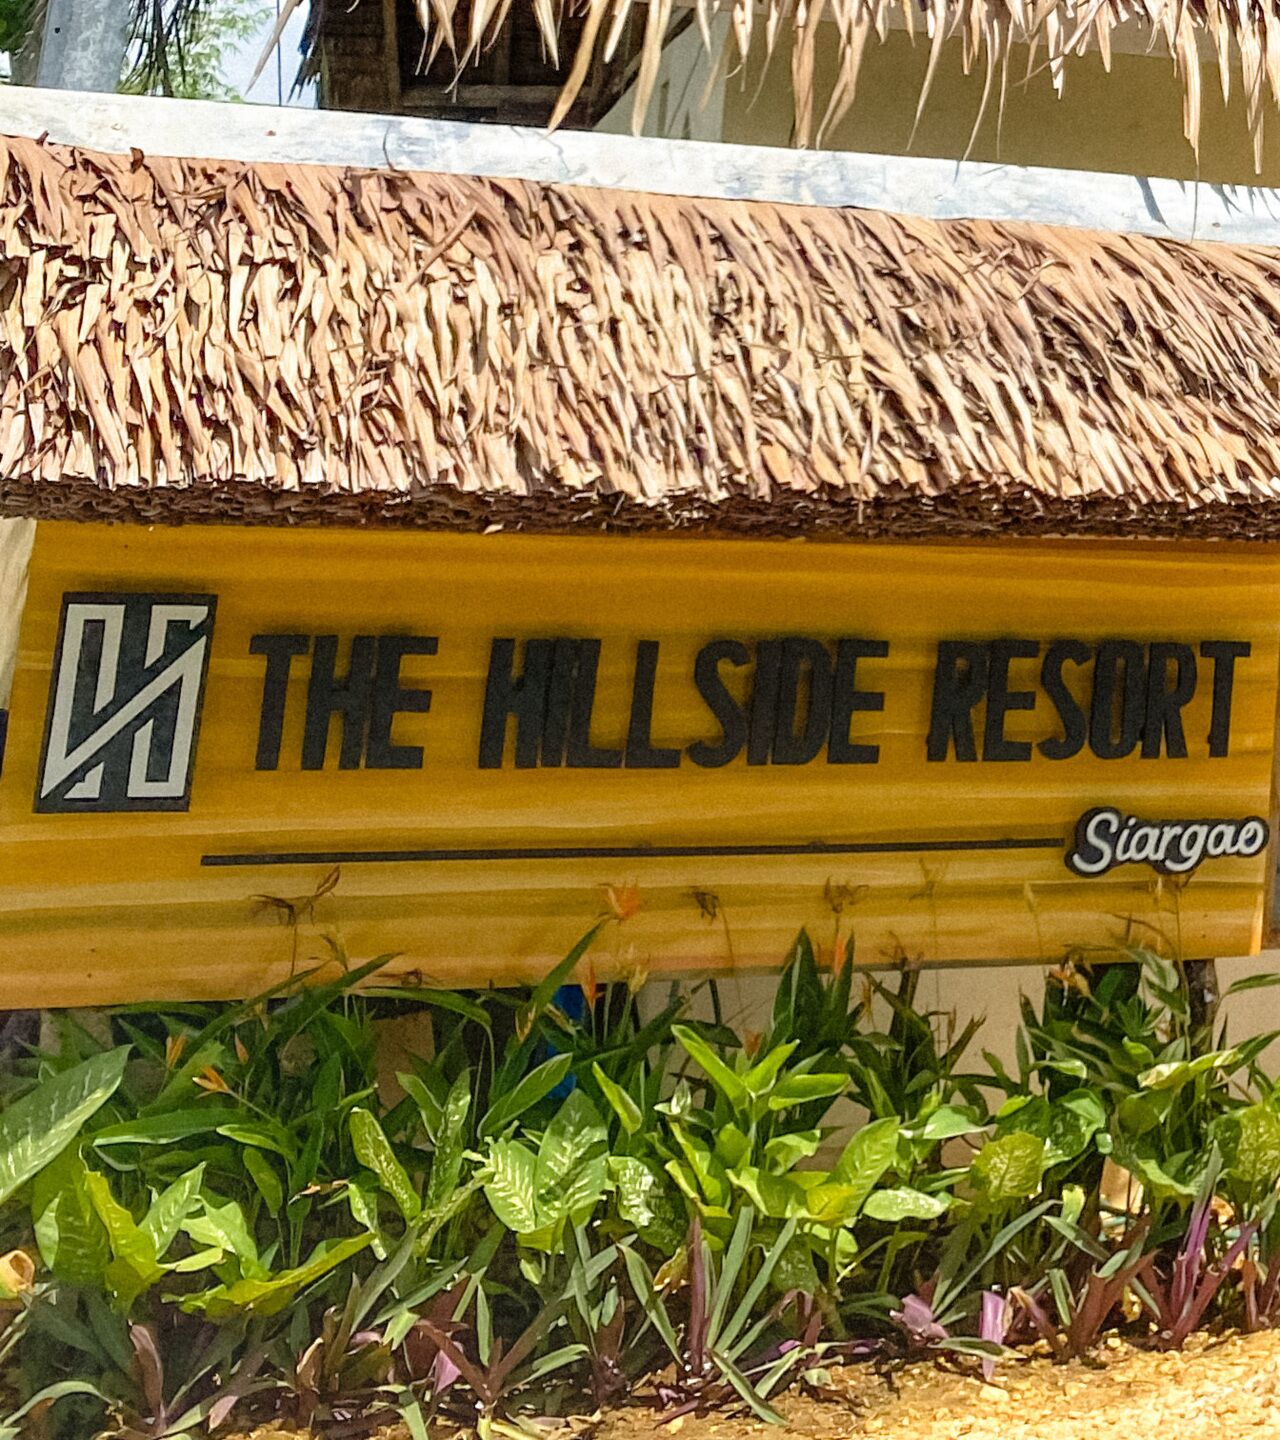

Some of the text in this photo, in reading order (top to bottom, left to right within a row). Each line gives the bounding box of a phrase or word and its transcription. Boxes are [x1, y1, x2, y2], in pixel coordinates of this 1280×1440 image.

[250, 635, 1252, 770] THE HILLSIDE RESORT
[1068, 809, 1267, 875] Siargao
